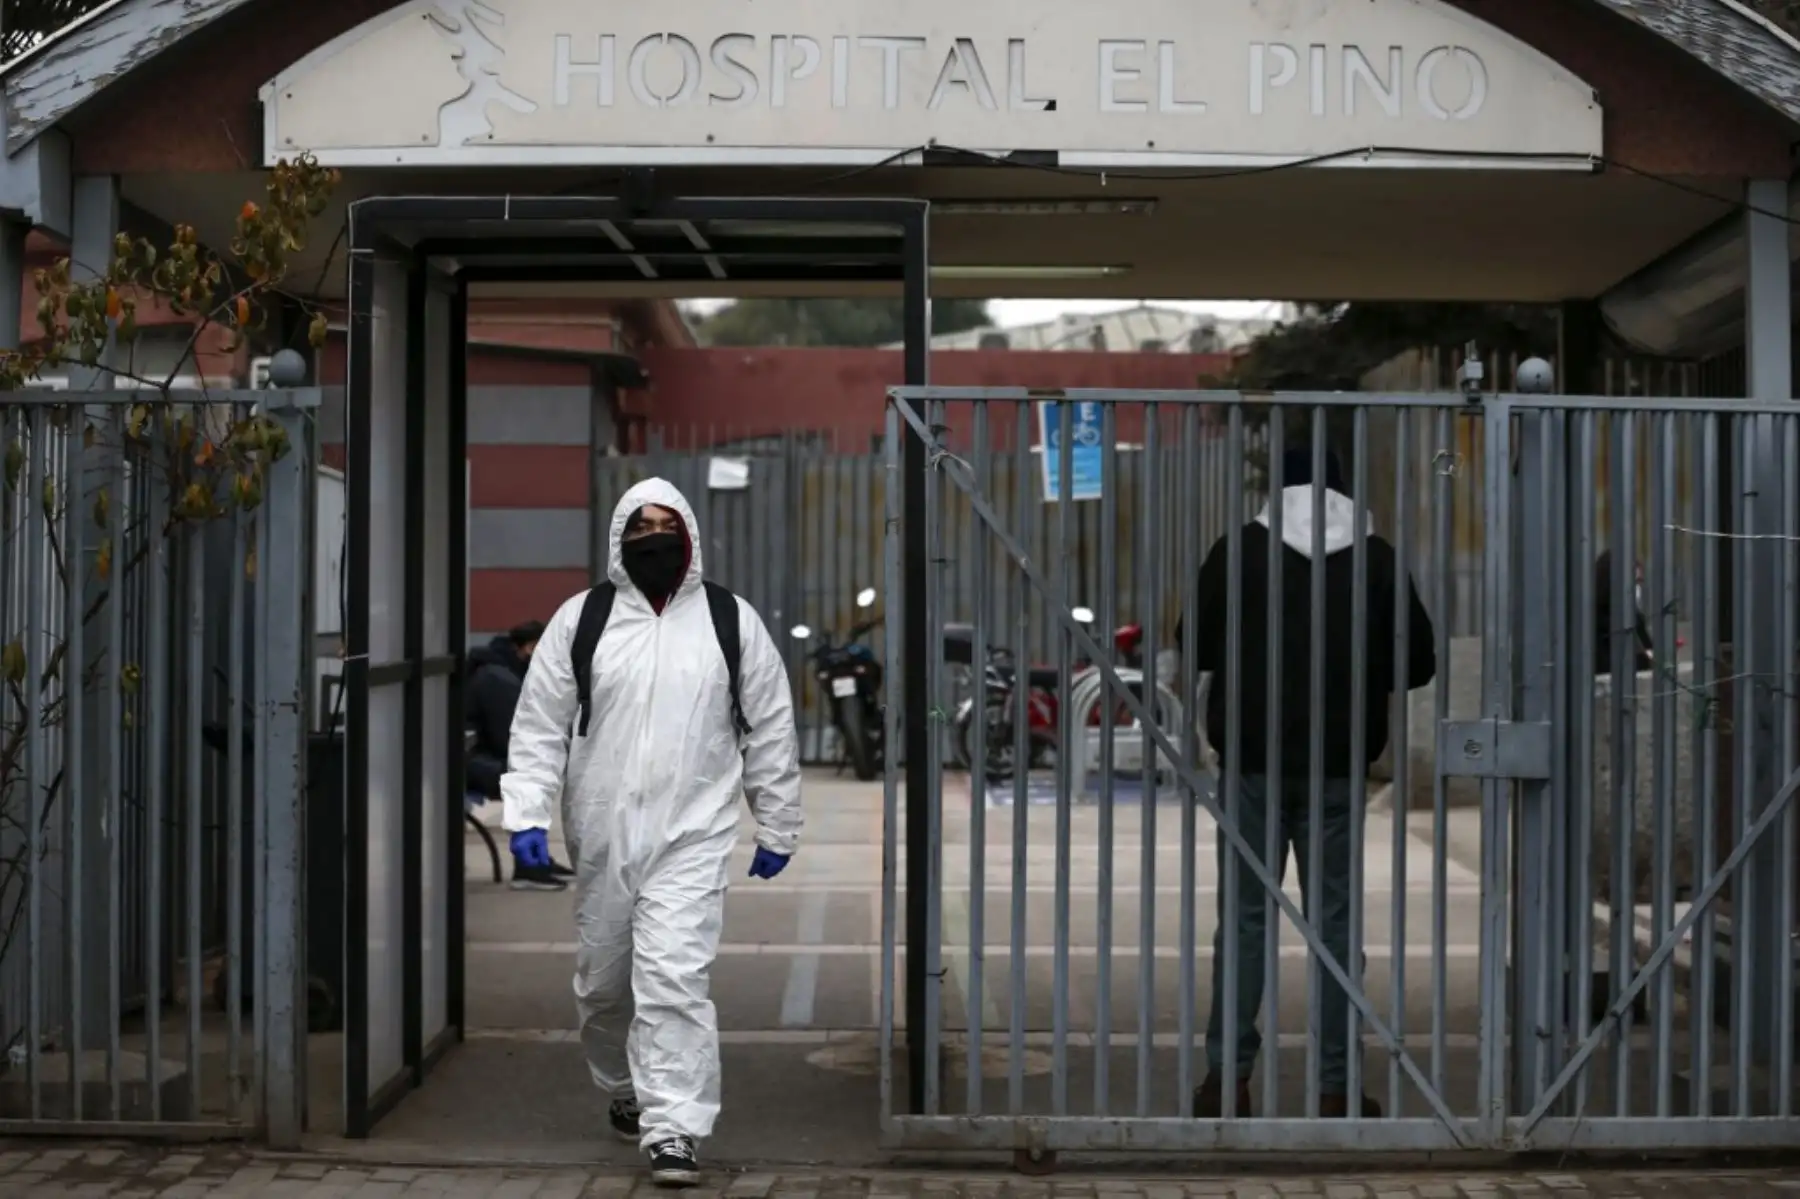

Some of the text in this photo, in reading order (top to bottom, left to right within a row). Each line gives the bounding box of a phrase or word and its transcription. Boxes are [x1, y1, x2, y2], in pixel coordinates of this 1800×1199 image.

[555, 33, 1489, 120] HOSPITAL EL PINO
